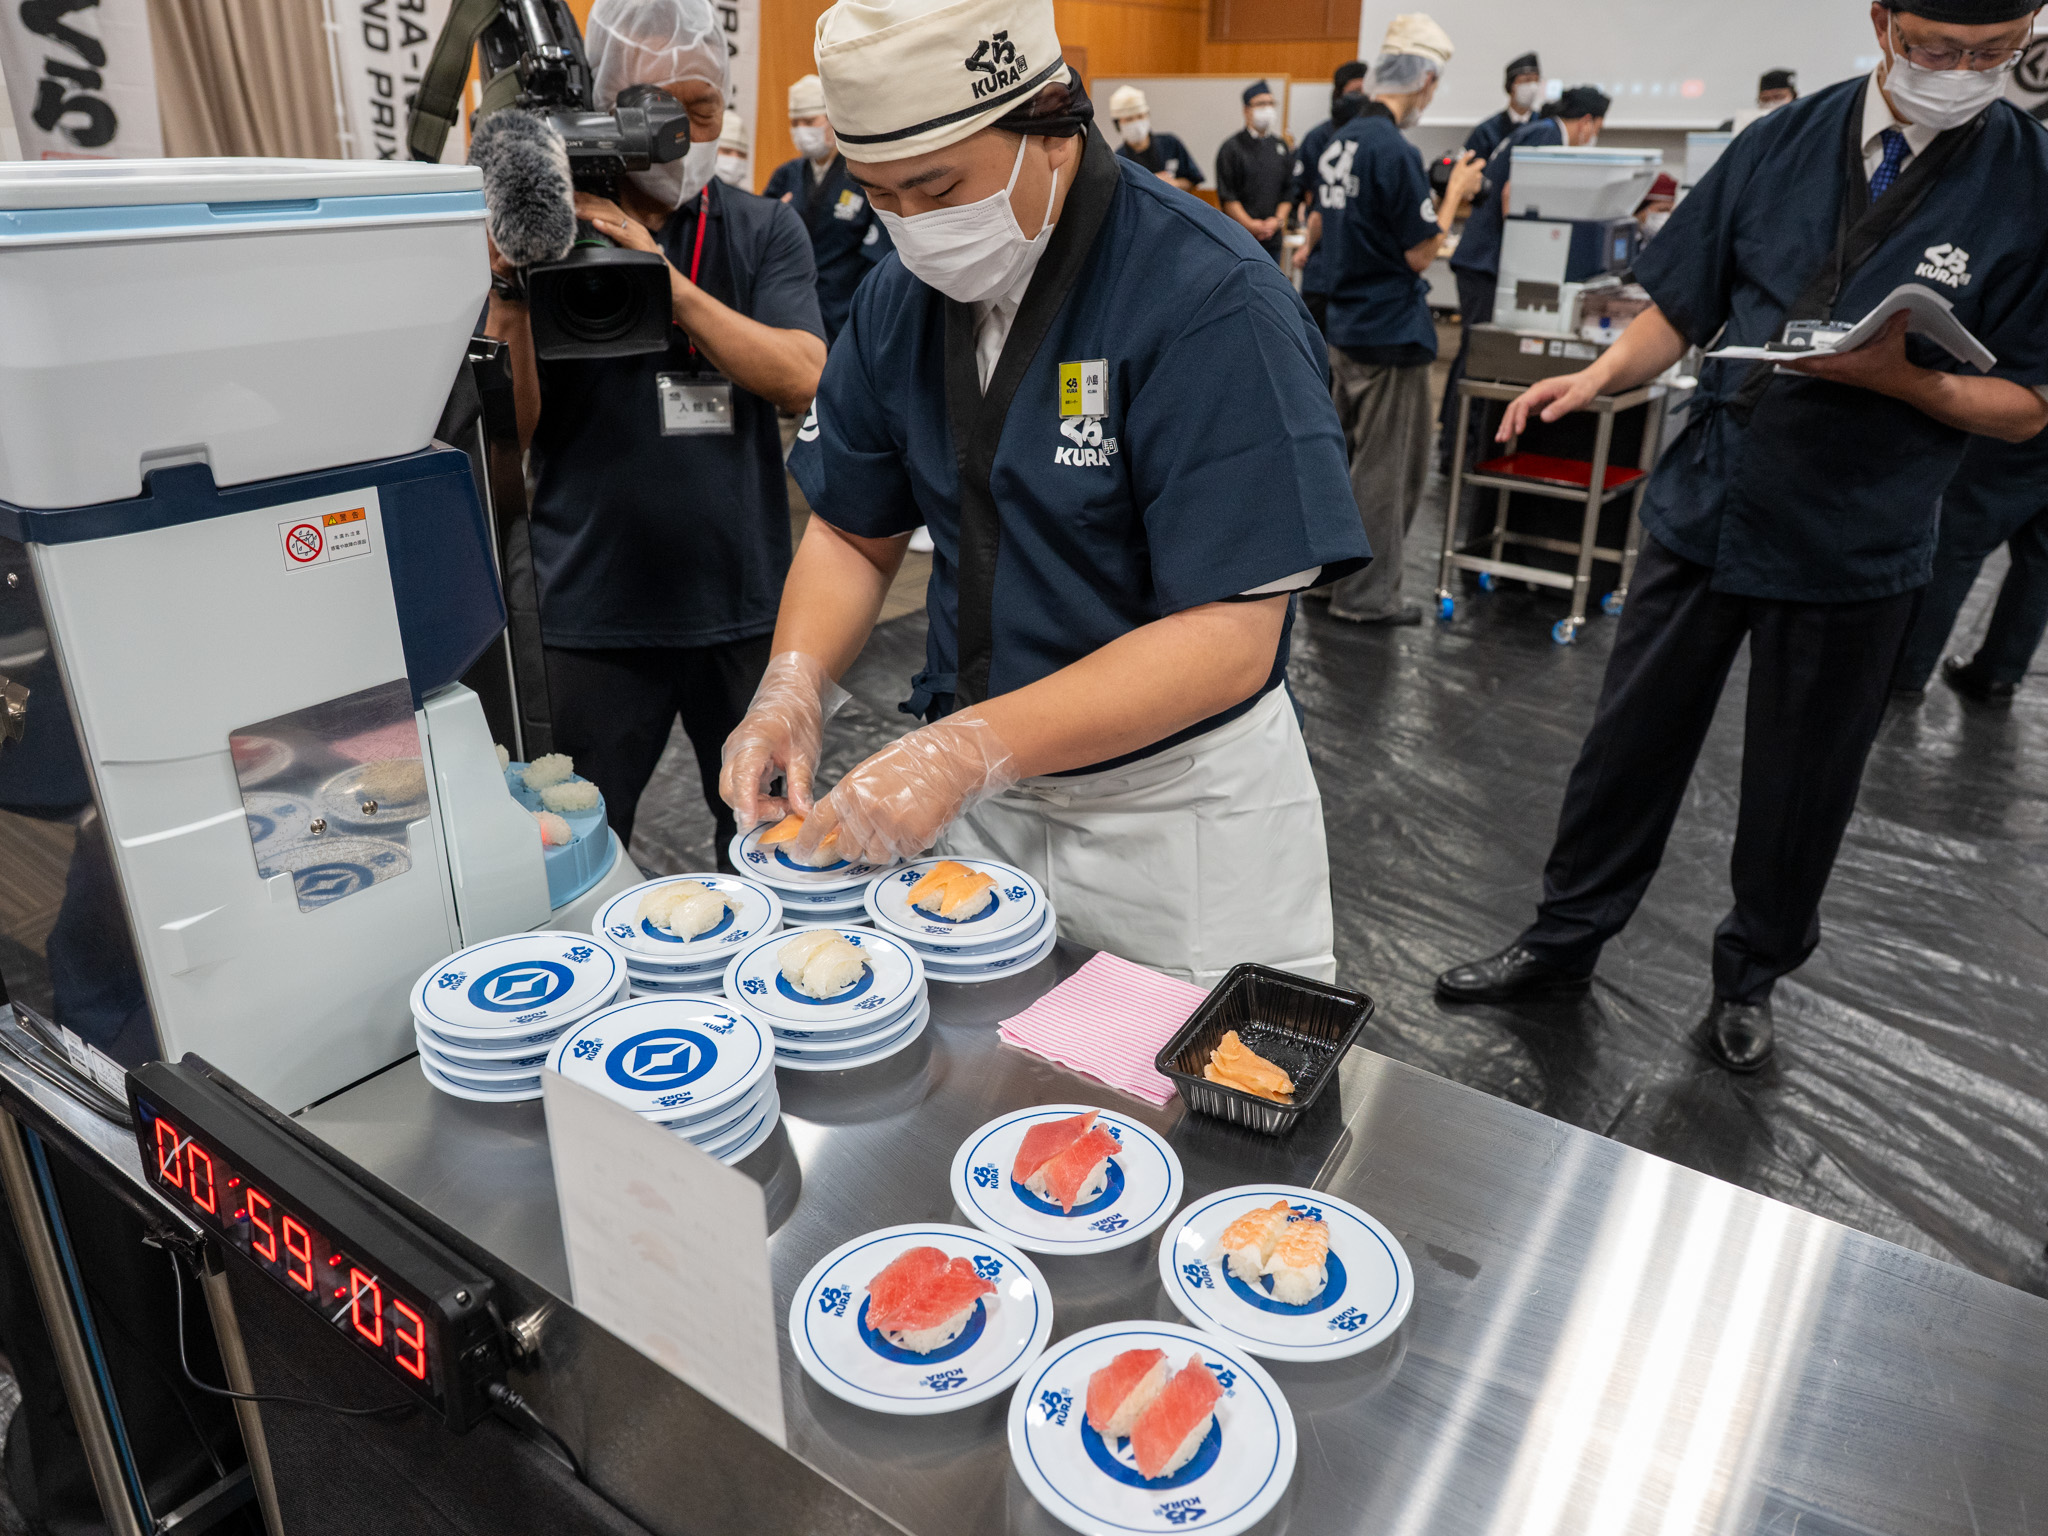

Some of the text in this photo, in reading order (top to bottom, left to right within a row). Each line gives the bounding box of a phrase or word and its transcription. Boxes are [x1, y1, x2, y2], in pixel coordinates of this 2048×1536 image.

[965, 29, 1016, 75] くら
[971, 65, 1022, 99] KURA
[1924, 242, 1970, 275] くら
[1914, 262, 1959, 289] KURA
[1054, 446, 1111, 467] KURA
[1003, 888, 1016, 902] KURA
[1011, 885, 1028, 900] くら
[562, 952, 584, 964] KURA
[570, 946, 594, 959] くら
[437, 973, 459, 990] くら
[449, 974, 468, 991] KURA
[742, 979, 759, 995] くら
[758, 976, 769, 995] KURA
[854, 994, 879, 1008] KURA
[573, 1039, 595, 1059] くら
[585, 1042, 604, 1062] KURA
[657, 1091, 691, 1101] KURA
[973, 1166, 991, 1188] くら
[990, 1168, 999, 1189] KURA
[1091, 1212, 1123, 1227] KURA
[1098, 1218, 1130, 1234] くら
[155, 1117, 426, 1380] 00:59:03
[973, 1255, 1004, 1277] くら
[1183, 1263, 1204, 1289] くら
[1199, 1264, 1215, 1290] KURA
[818, 1287, 842, 1314] くら
[833, 1291, 853, 1318] KURA
[1328, 1306, 1359, 1326] KURA
[1338, 1312, 1369, 1332] くら
[926, 1367, 964, 1381] KURA
[930, 1376, 968, 1392] くら
[1039, 1390, 1062, 1422] くら
[1055, 1395, 1074, 1427] KURA
[1160, 1496, 1202, 1511] KURA
[1165, 1507, 1207, 1525] くら
